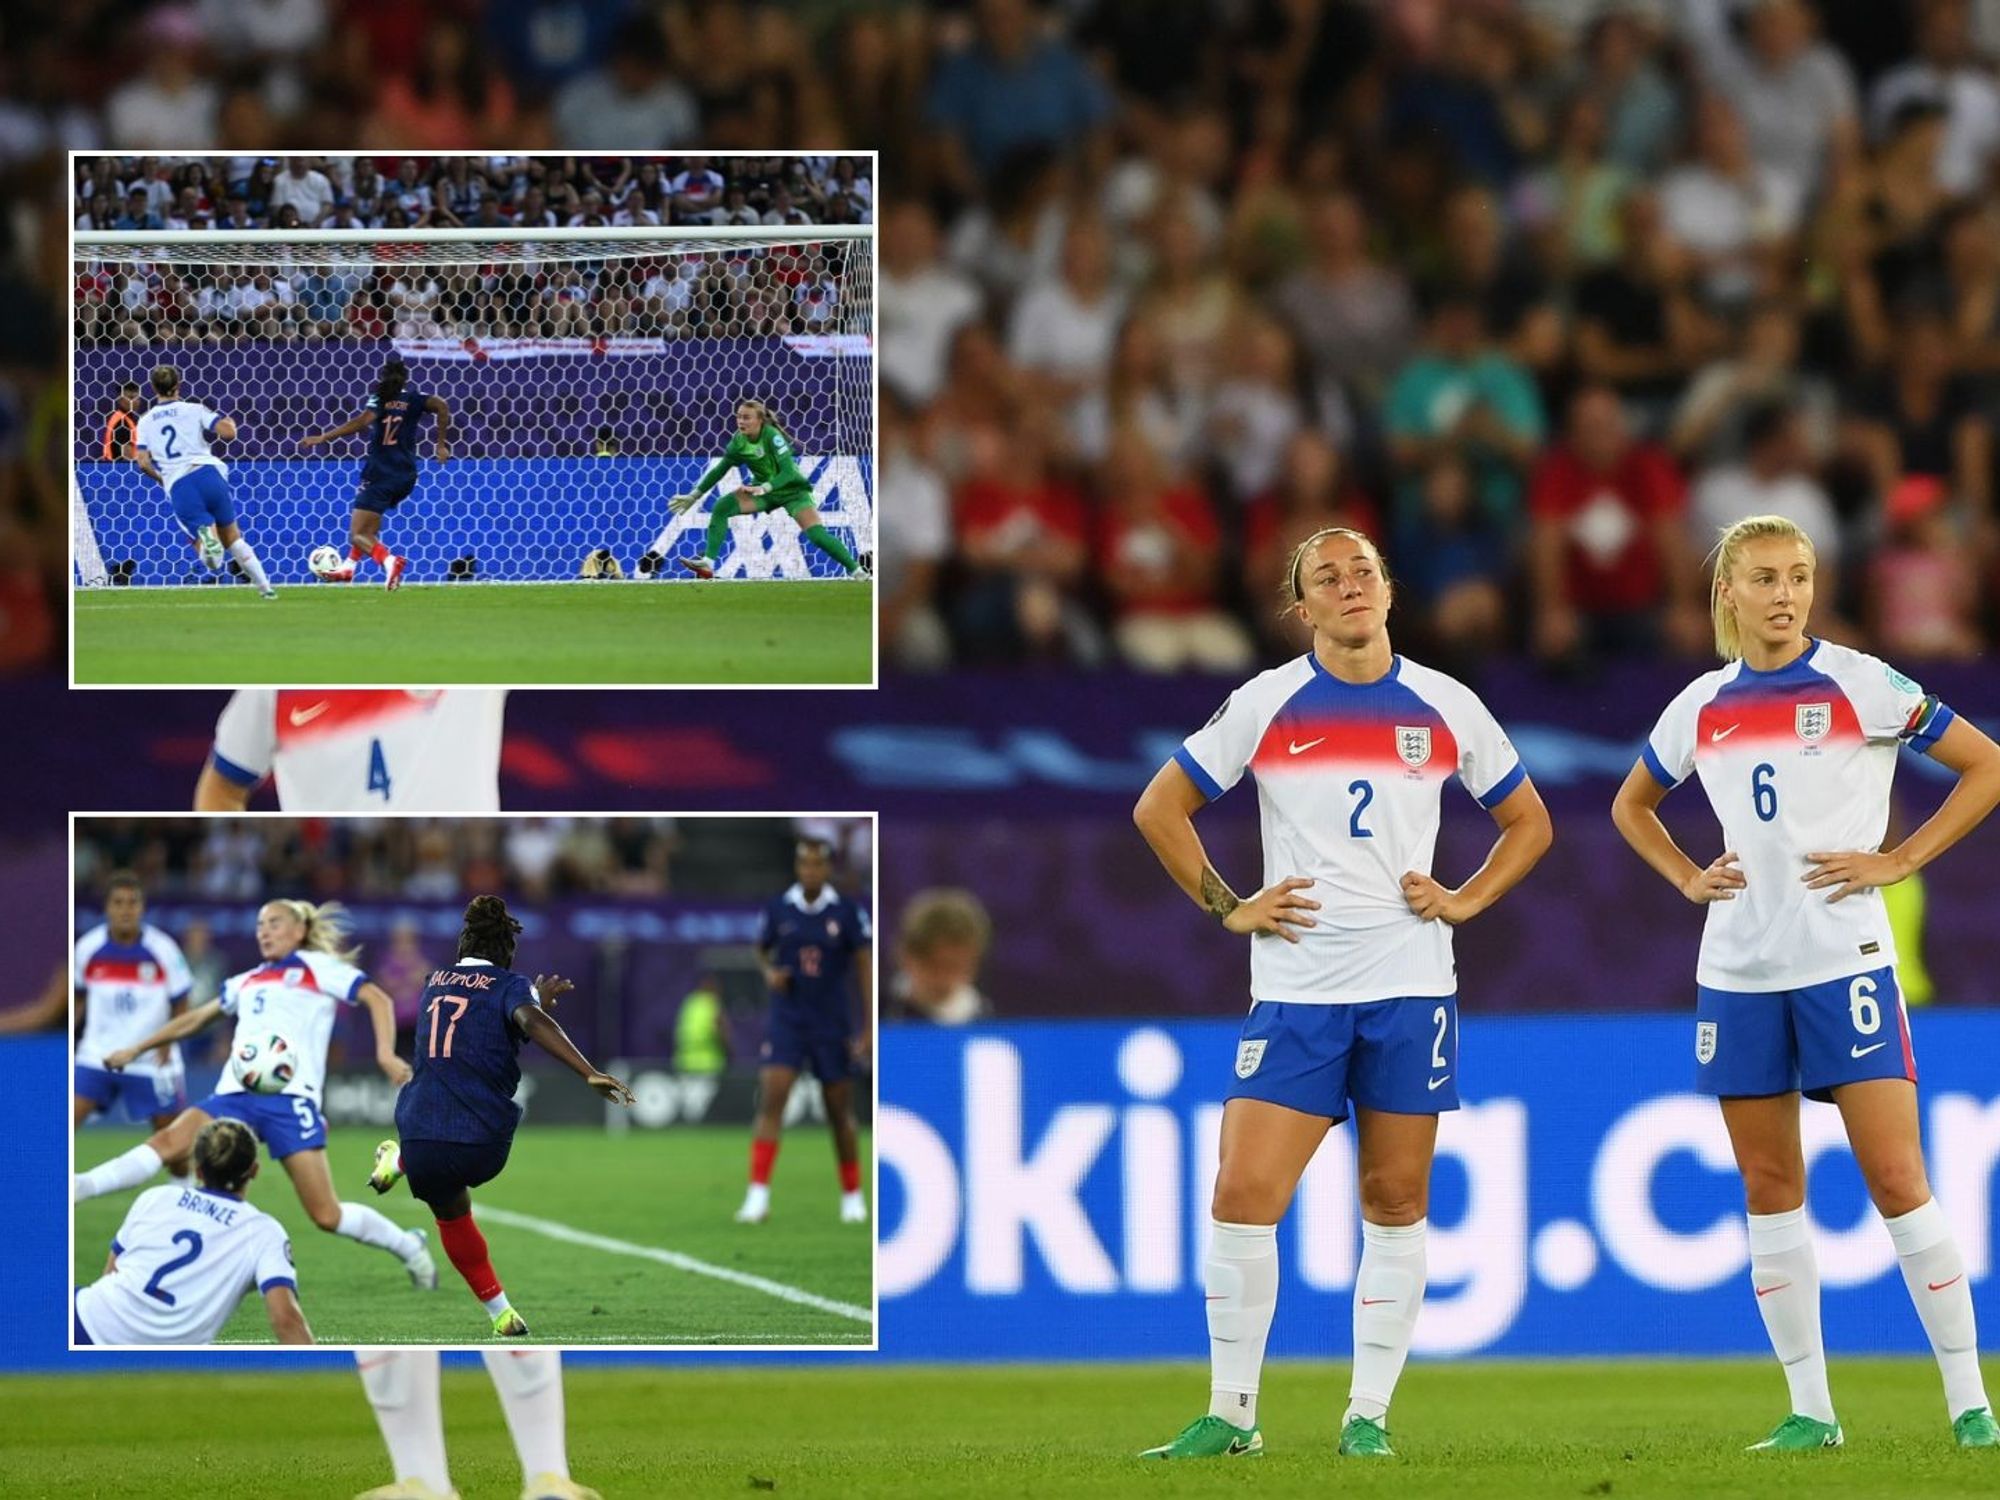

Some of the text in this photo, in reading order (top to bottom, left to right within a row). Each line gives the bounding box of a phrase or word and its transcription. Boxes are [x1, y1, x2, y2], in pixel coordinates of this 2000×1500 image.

[161, 424, 182, 459] 2
[382, 415, 403, 446] 12
[368, 738, 391, 801] 4
[1751, 762, 1779, 822] 6
[1347, 779, 1375, 838] 2
[252, 989, 267, 1014] 5
[428, 970, 497, 991] BALTIMORE
[1848, 976, 1882, 1035] 6
[426, 995, 469, 1058] 17
[1431, 1006, 1447, 1068] 2
[292, 1097, 315, 1129] 5
[177, 1189, 239, 1227] BRONZE
[142, 1228, 203, 1307] 2
